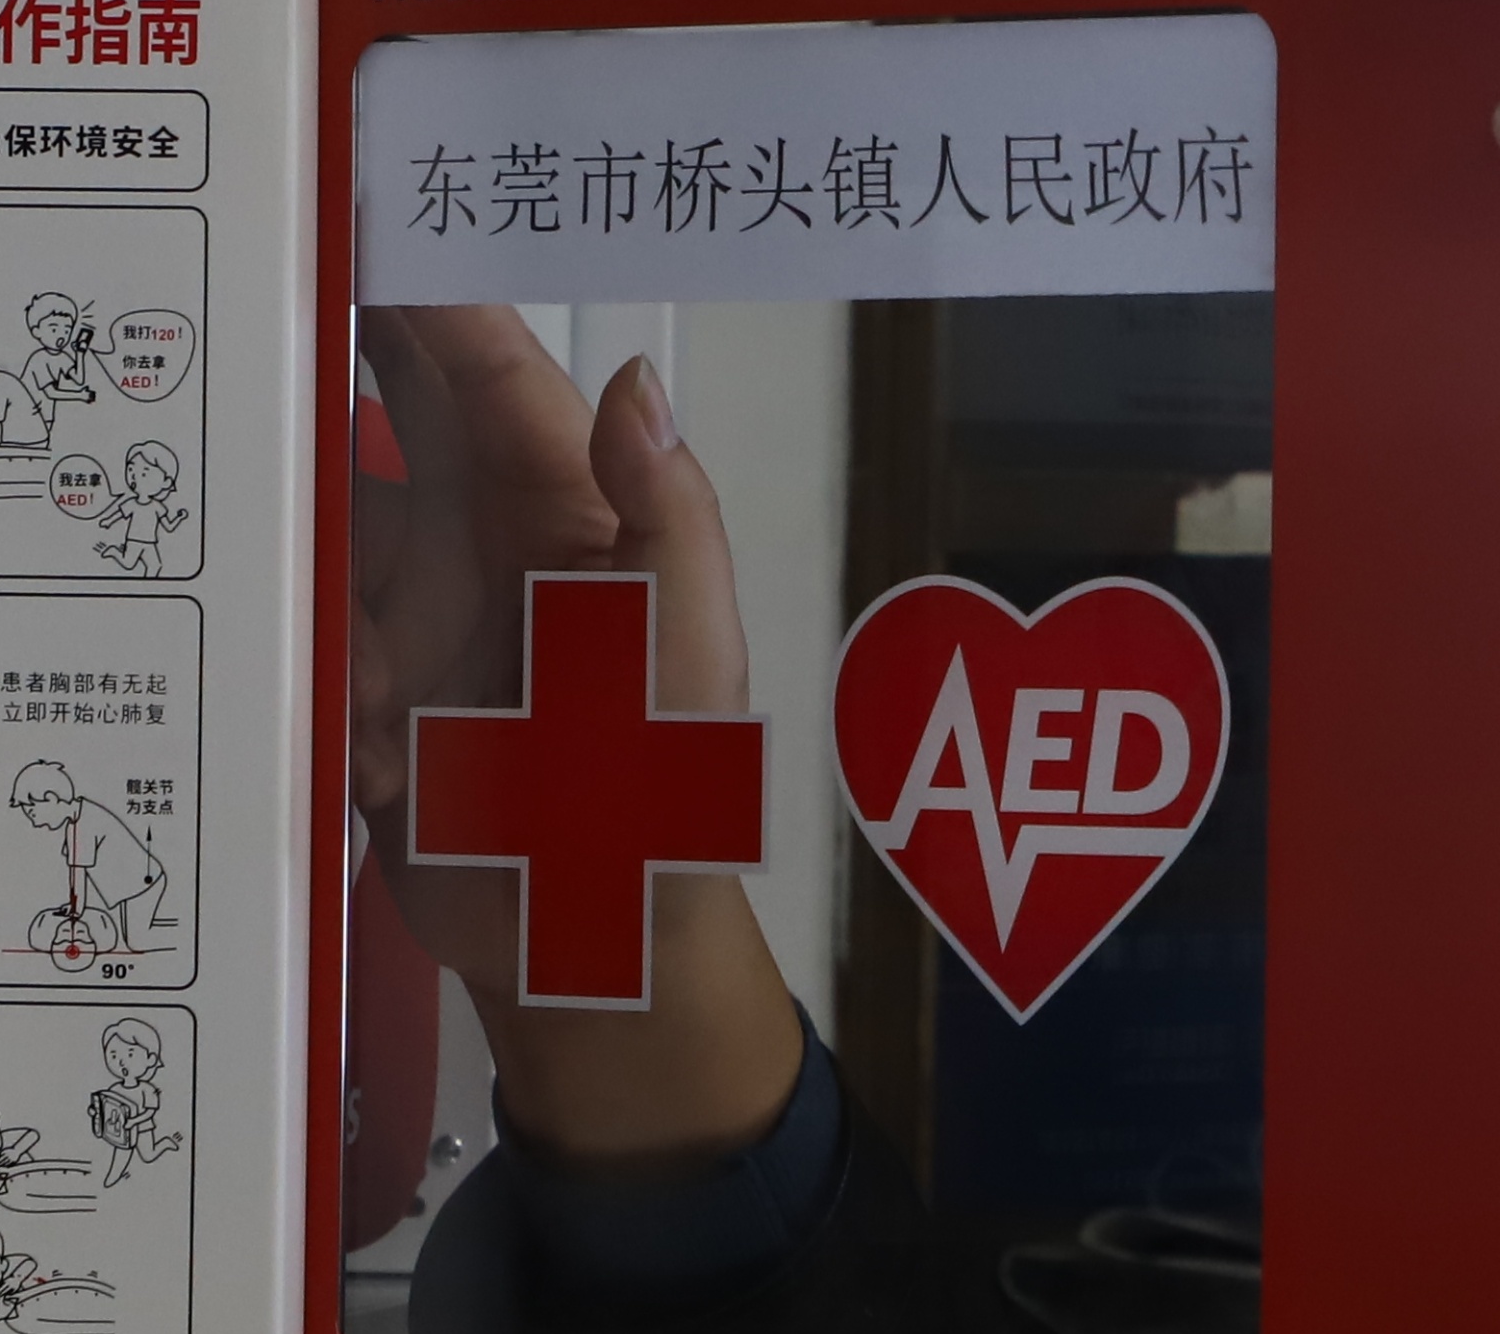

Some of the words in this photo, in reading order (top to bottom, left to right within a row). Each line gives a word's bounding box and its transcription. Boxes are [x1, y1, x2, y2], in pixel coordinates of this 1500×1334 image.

[407, 126, 1254, 236] 东莞市桥头镇人民政府
[122, 355, 165, 369] 你去拿
[59, 472, 102, 487] 我去拿
[887, 643, 1191, 860] AED
[126, 799, 173, 815] 为支点
